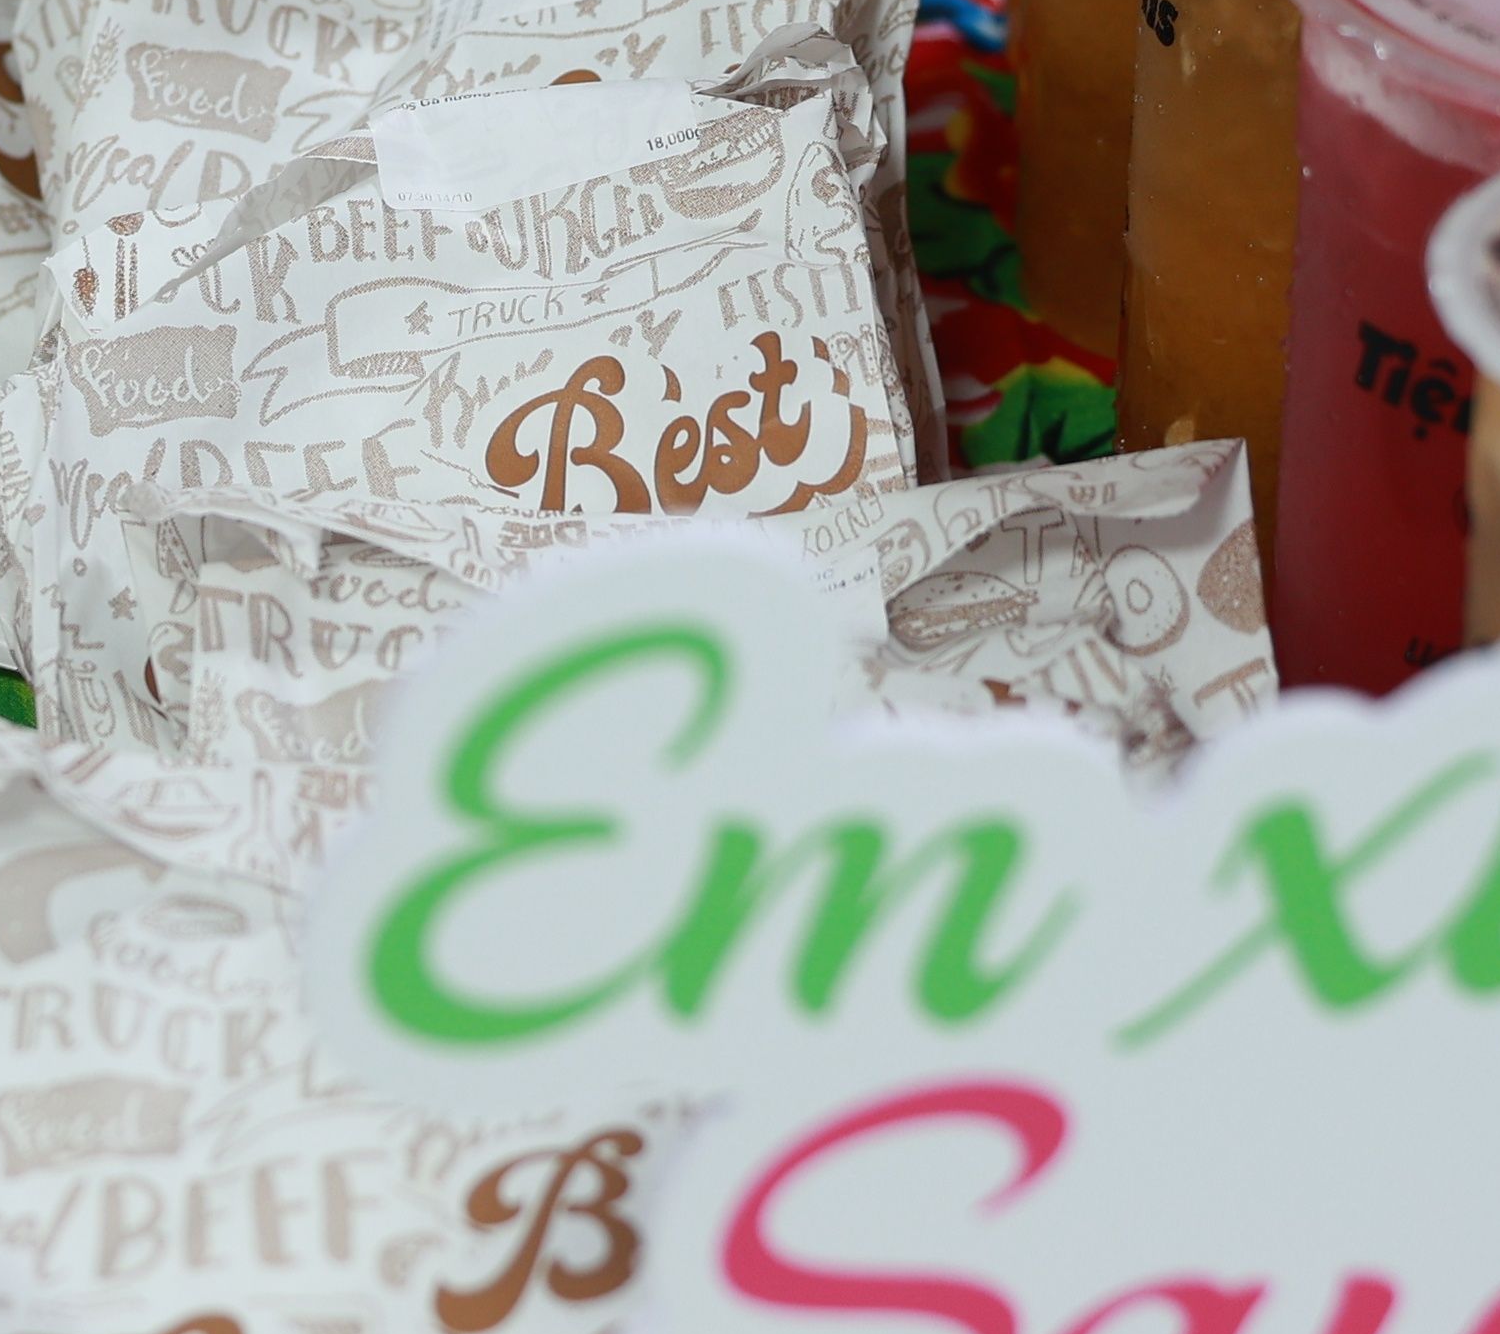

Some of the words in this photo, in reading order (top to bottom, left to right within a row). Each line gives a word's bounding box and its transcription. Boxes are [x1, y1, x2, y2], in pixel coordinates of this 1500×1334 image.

[307, 196, 455, 262] BEEF
[448, 287, 568, 339] TRUCK
[197, 585, 424, 678] TRUC
[366, 622, 1080, 1050] Em
